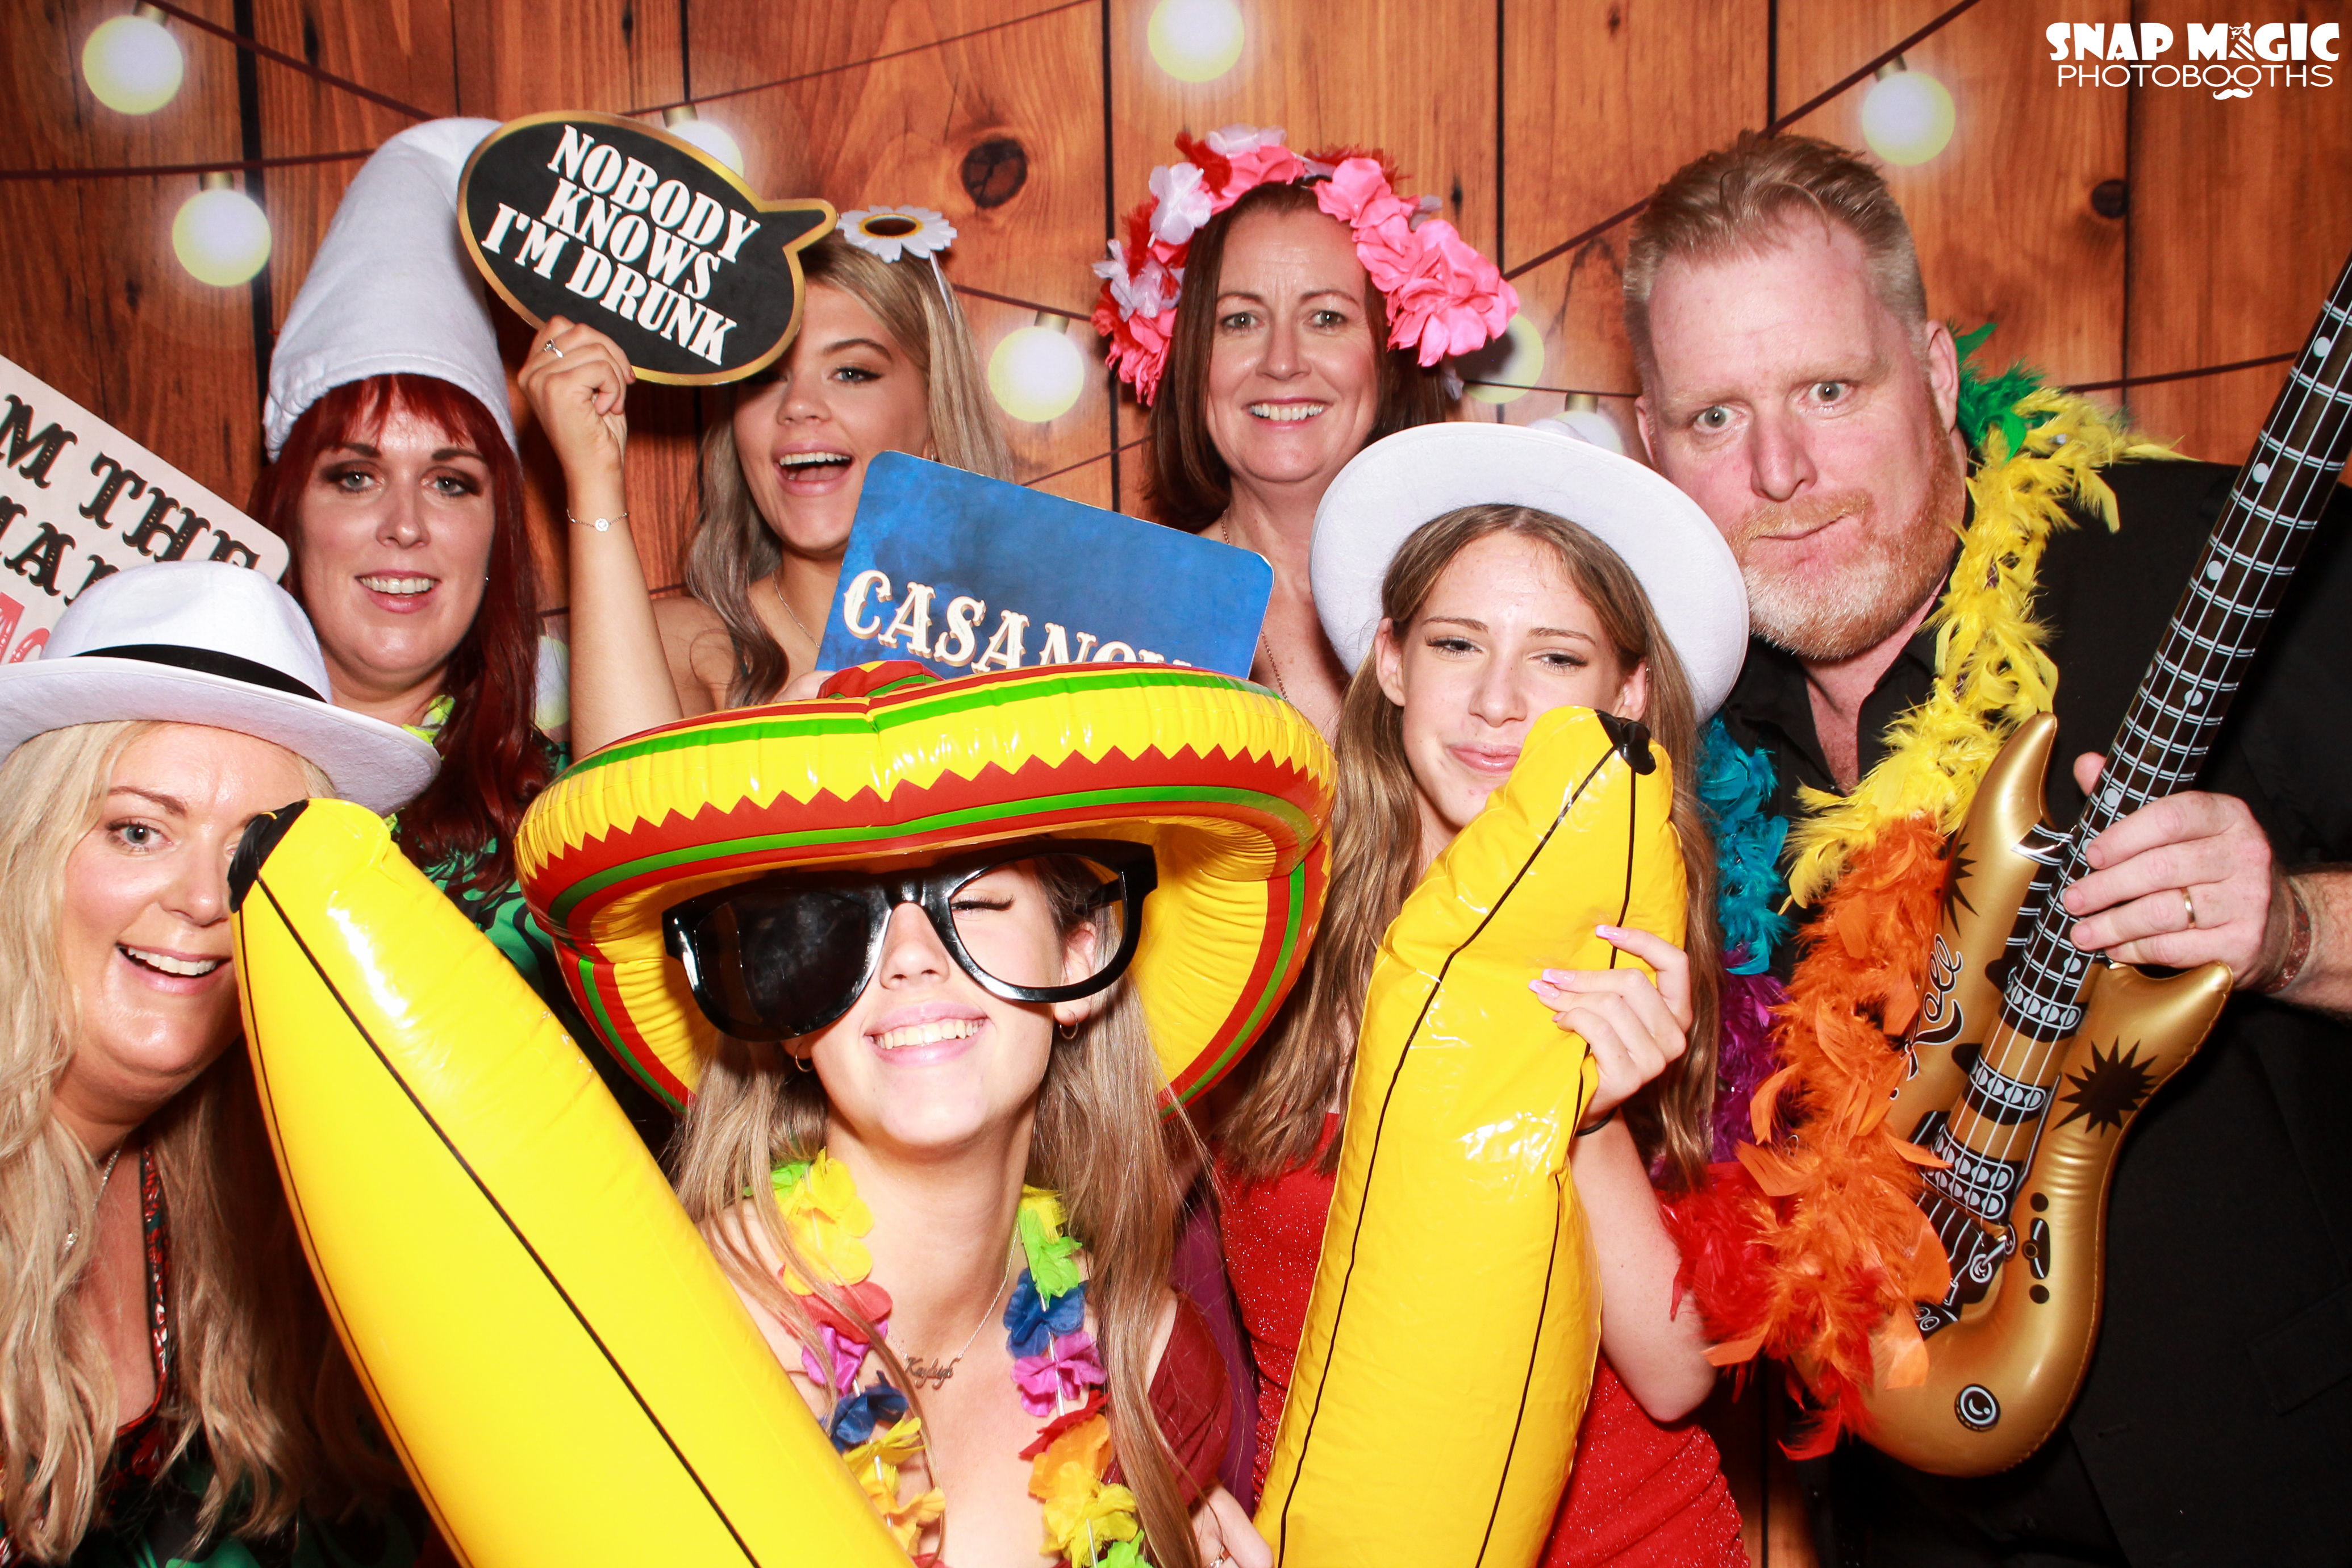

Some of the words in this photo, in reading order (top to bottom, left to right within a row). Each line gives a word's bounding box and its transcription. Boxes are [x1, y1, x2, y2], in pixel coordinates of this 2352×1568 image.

[541, 177, 720, 300] KNOWS
[547, 124, 760, 263] NOBODY
[481, 202, 569, 280] I'M
[565, 245, 737, 366] DRUNK
[843, 569, 1192, 674] CASAN
